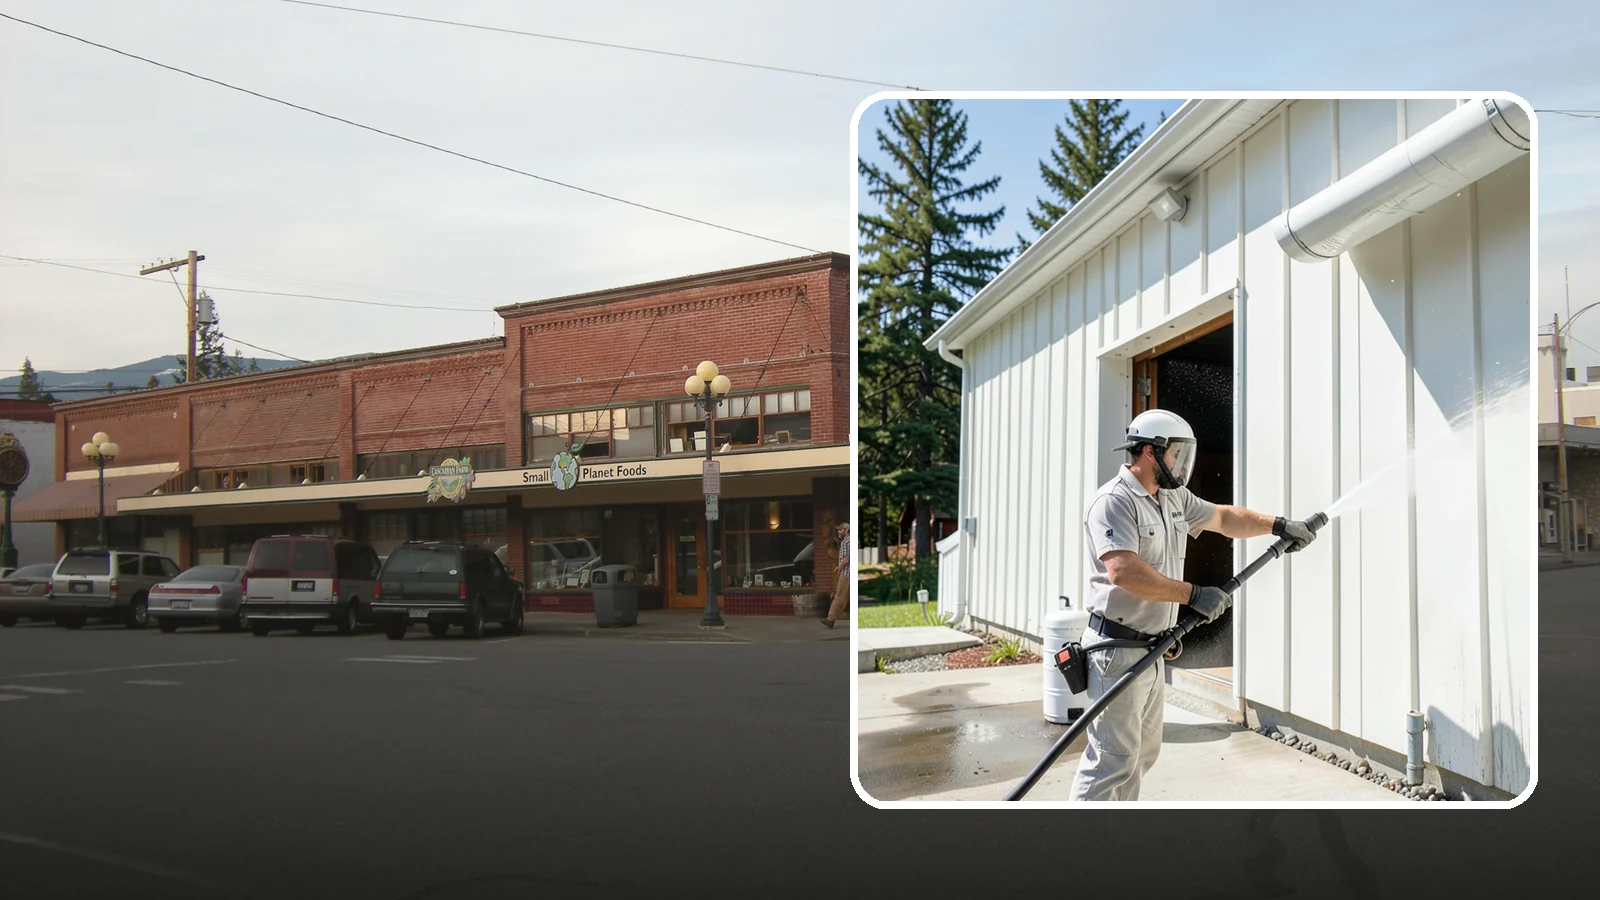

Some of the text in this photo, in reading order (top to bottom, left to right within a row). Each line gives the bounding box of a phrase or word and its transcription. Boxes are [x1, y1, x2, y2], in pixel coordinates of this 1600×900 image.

[523, 464, 647, 483] Small Planet Foods
